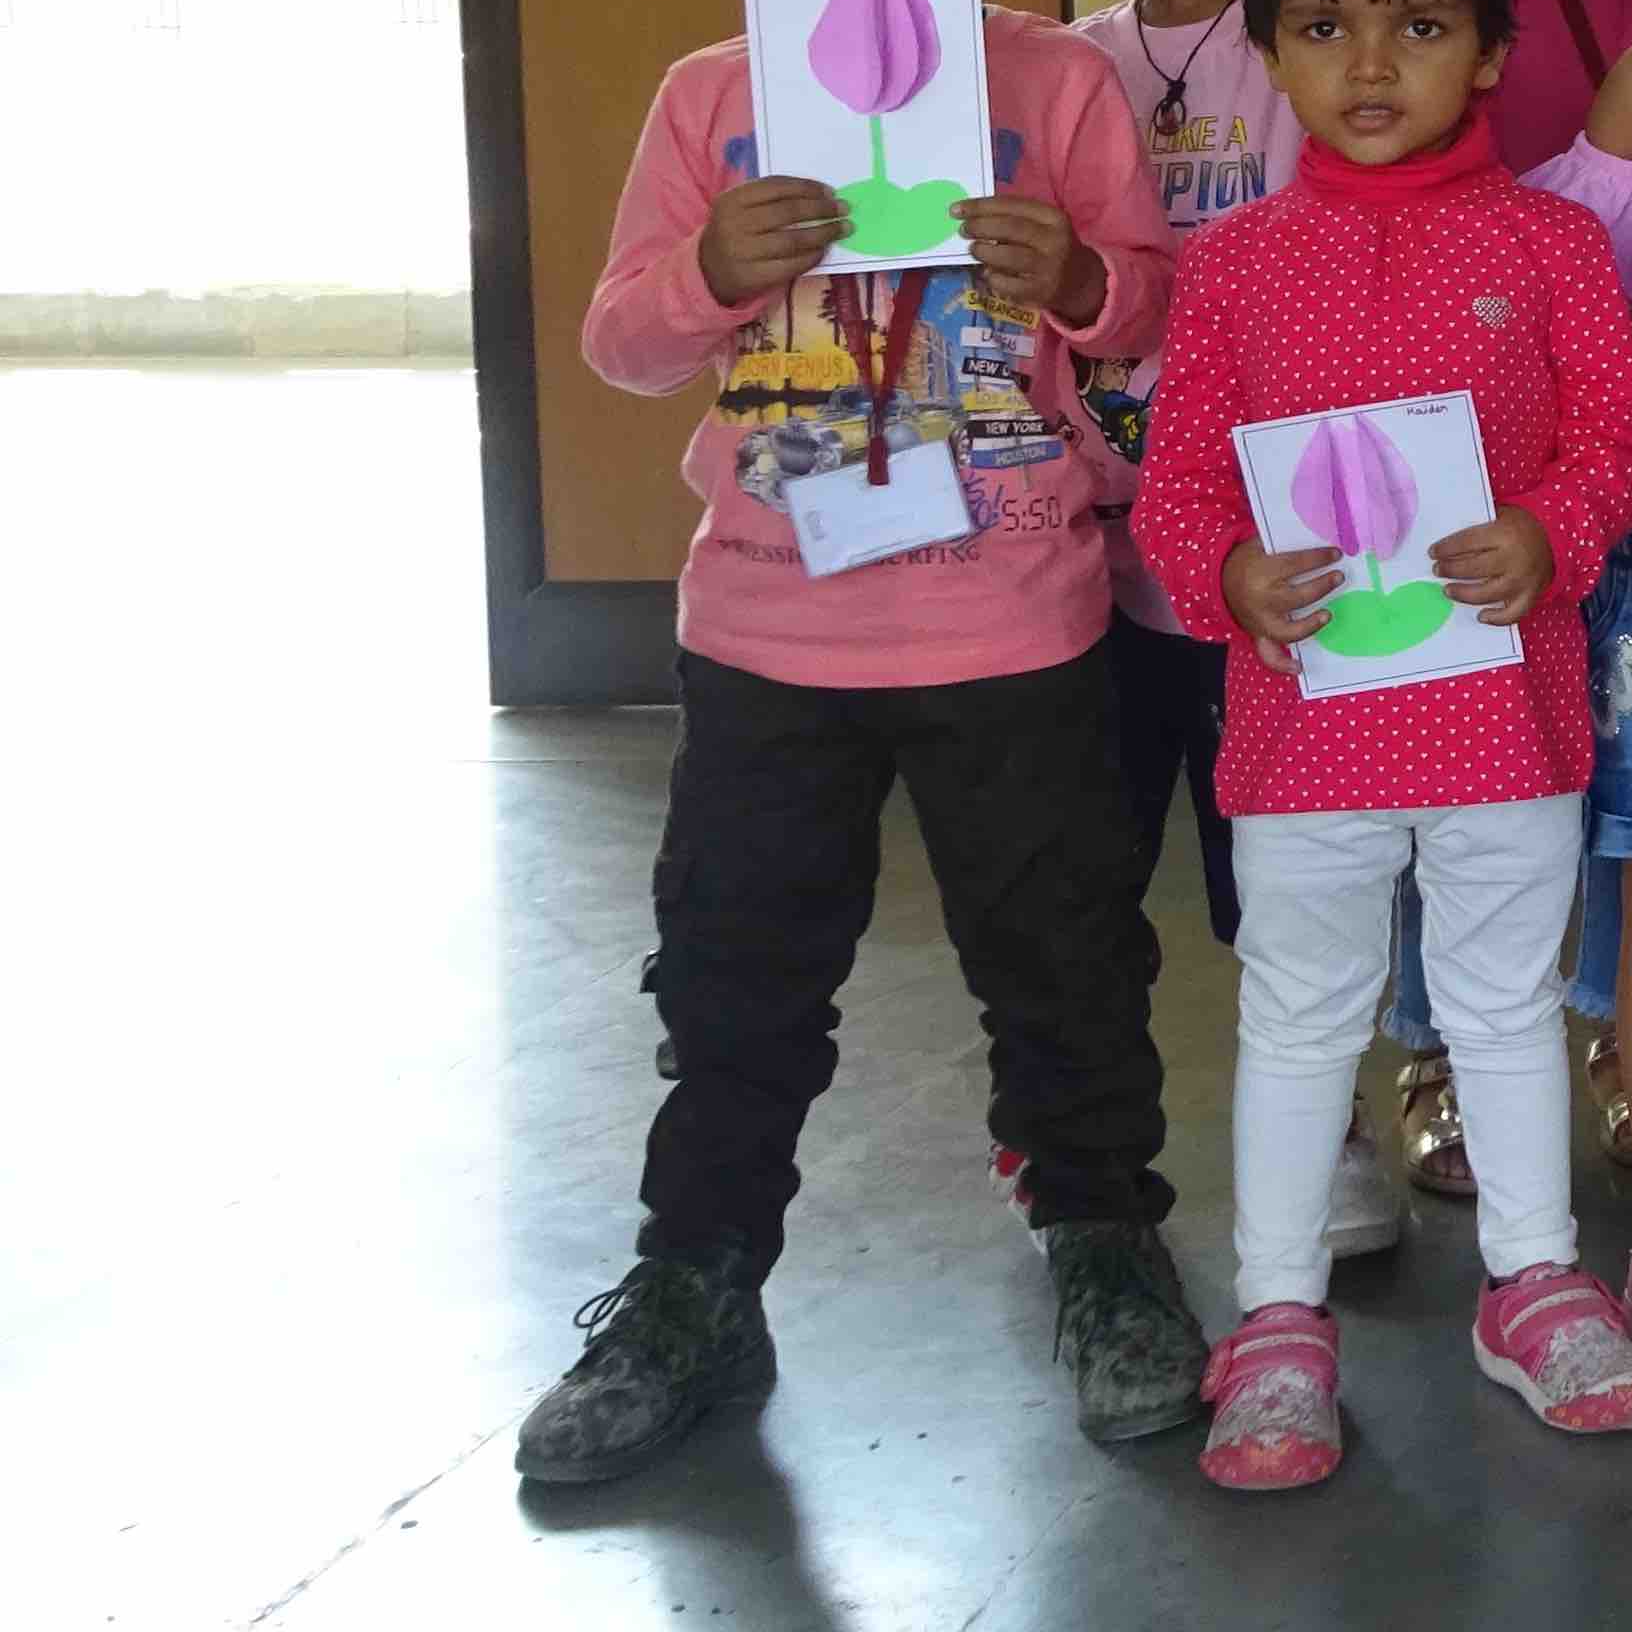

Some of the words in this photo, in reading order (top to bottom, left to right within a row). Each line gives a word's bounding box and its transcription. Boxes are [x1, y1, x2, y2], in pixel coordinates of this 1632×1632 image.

[1223, 115, 1249, 151] A
[968, 359, 999, 377] NEW
[985, 422, 1009, 434] NEW
[1013, 421, 1045, 434] YORK
[877, 545, 981, 566] URFING
